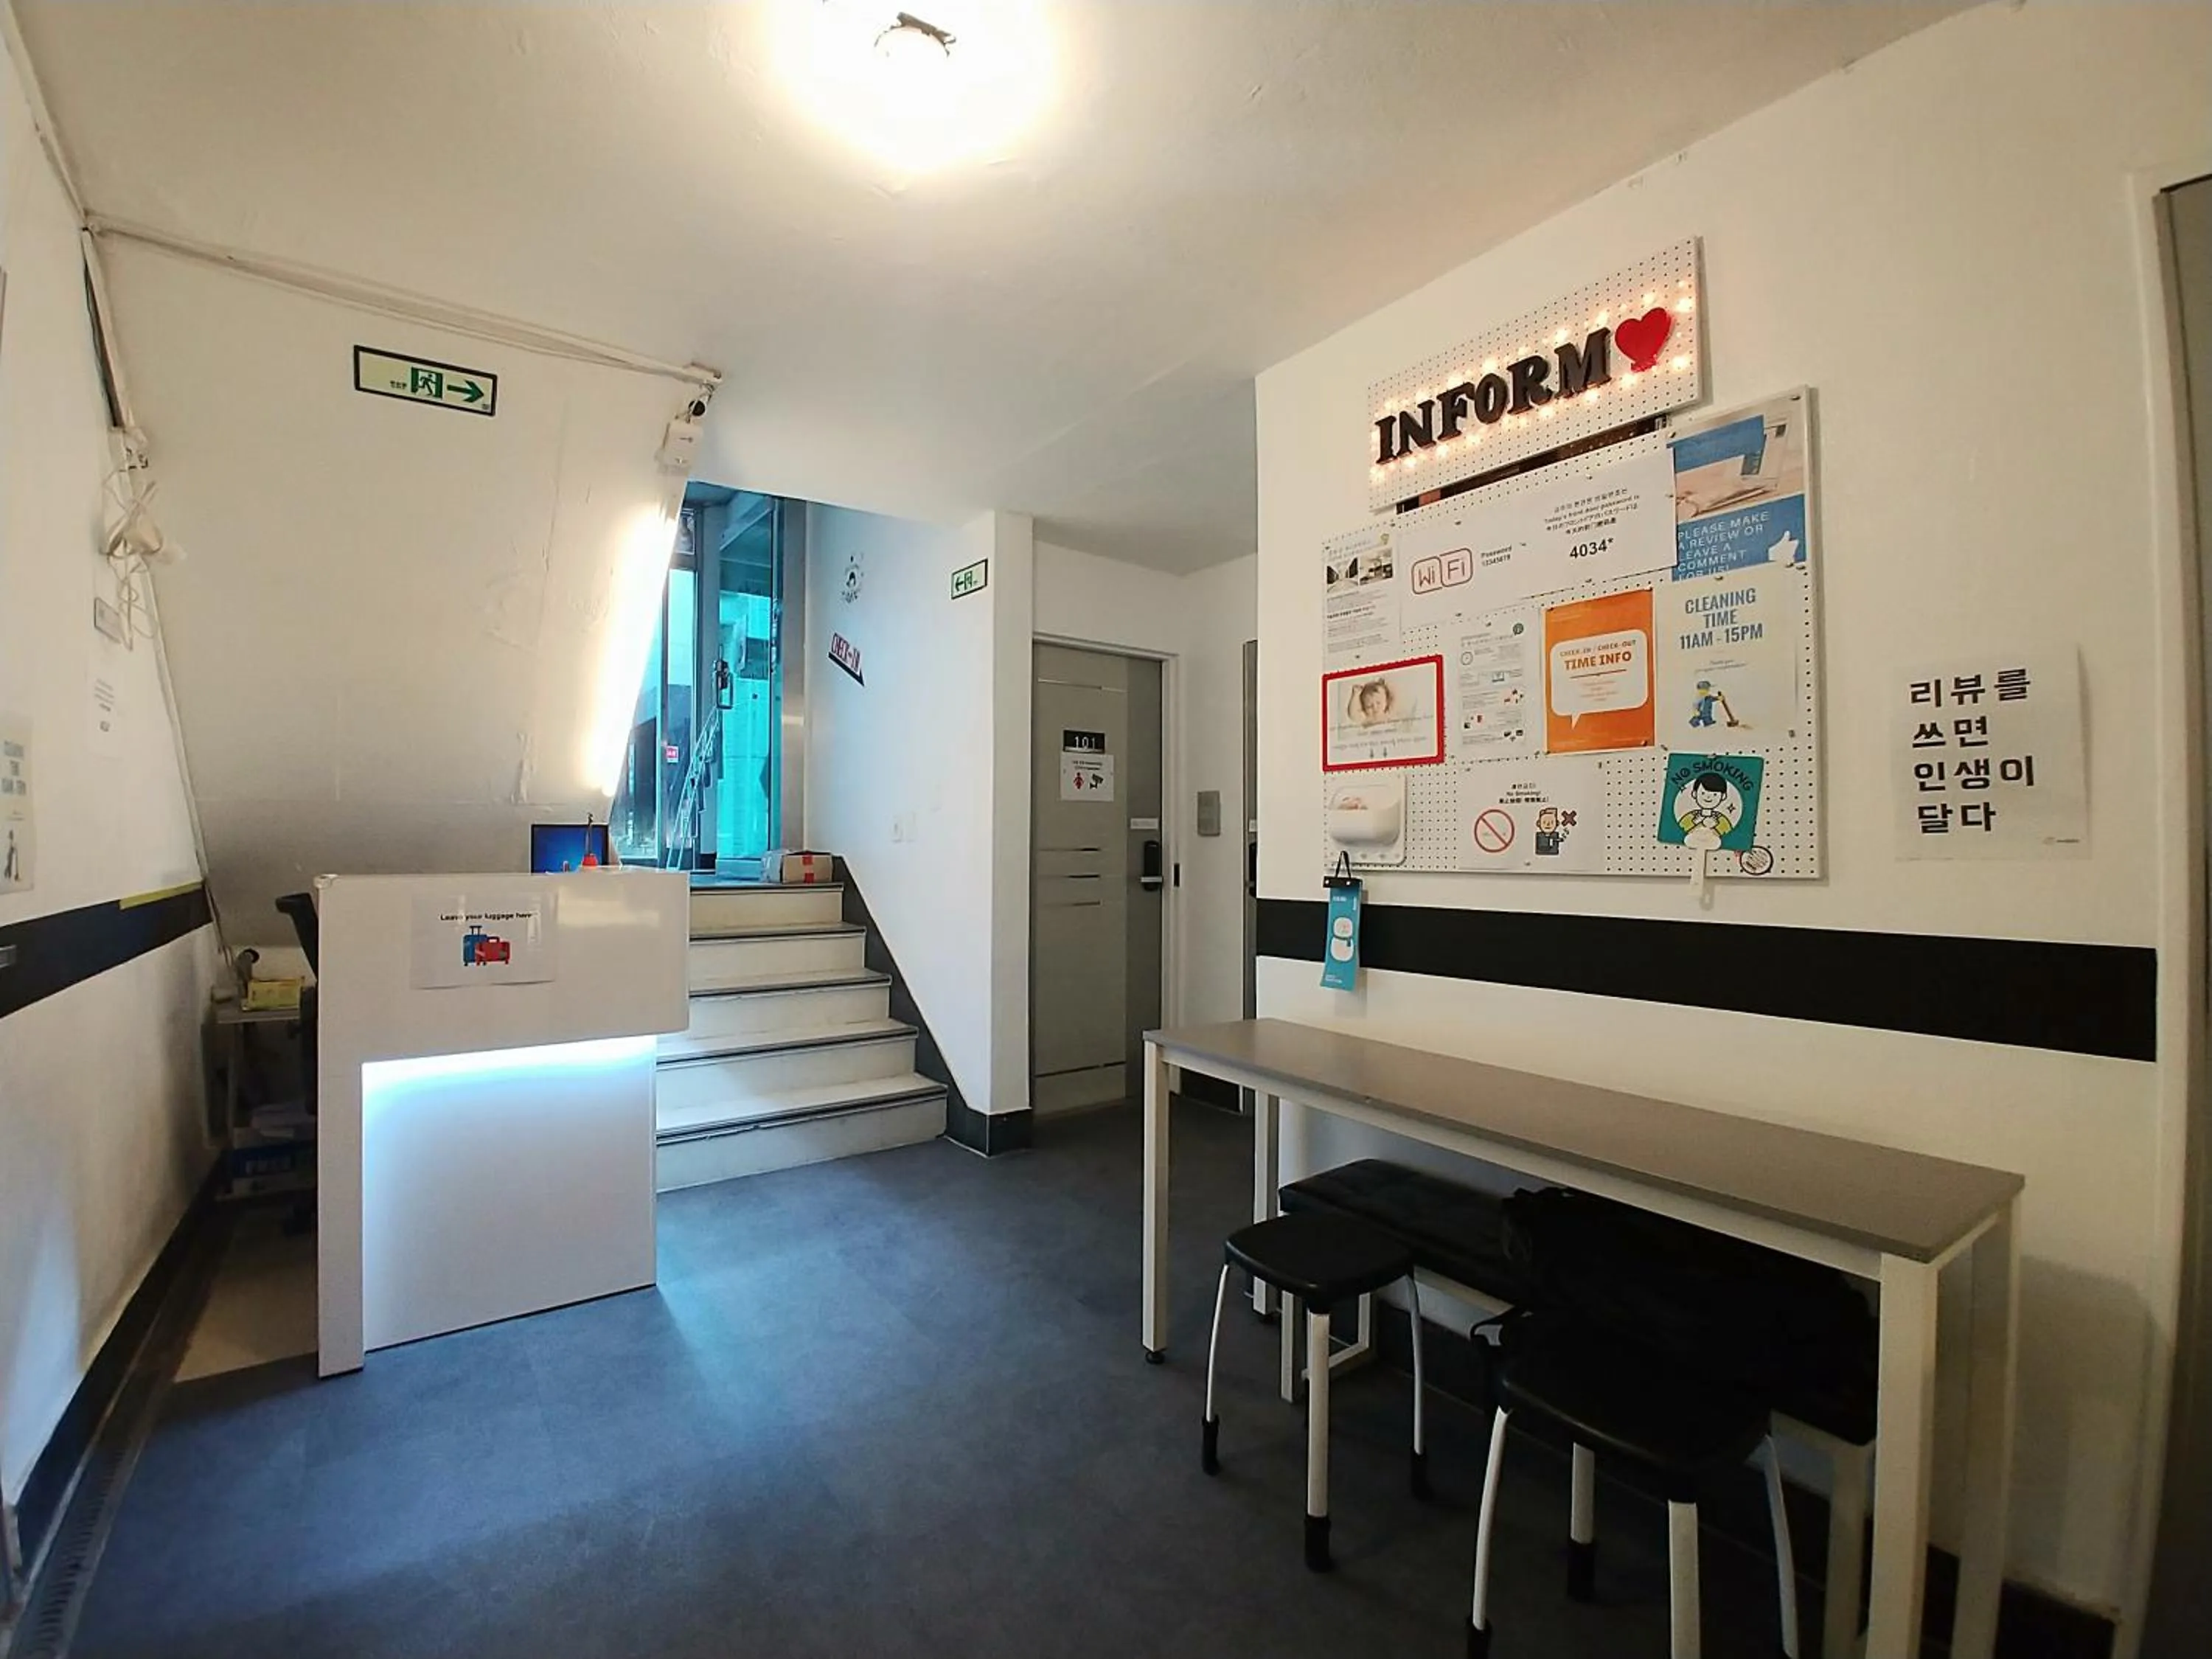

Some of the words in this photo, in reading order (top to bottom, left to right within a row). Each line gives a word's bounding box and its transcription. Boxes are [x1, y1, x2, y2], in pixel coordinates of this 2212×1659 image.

[1375, 327, 1612, 465] INFORM
[1677, 521, 1726, 540] PLEASE
[1731, 511, 1770, 528] MAKE
[1689, 529, 1740, 547] REVIEW
[1745, 524, 1764, 536] OR
[1677, 549, 1747, 572] COMMENT
[1678, 546, 1718, 563] LEAVE
[1722, 542, 1731, 552] A
[1685, 588, 1756, 614] CLEANING
[1703, 608, 1739, 628] TIME
[1680, 631, 1713, 650] 11AM
[1725, 623, 1763, 644] 15PM
[1564, 656, 1596, 671] TIME
[1599, 651, 1632, 666] INFO
[1910, 669, 2031, 707] 리뷰를
[1074, 736, 1096, 750] 101
[1913, 716, 1989, 748] 쓰면
[1671, 768, 1691, 785] NO
[1692, 760, 1754, 791] SMOKING
[1913, 755, 2035, 792] 인생이
[1917, 802, 1996, 834] 달다
